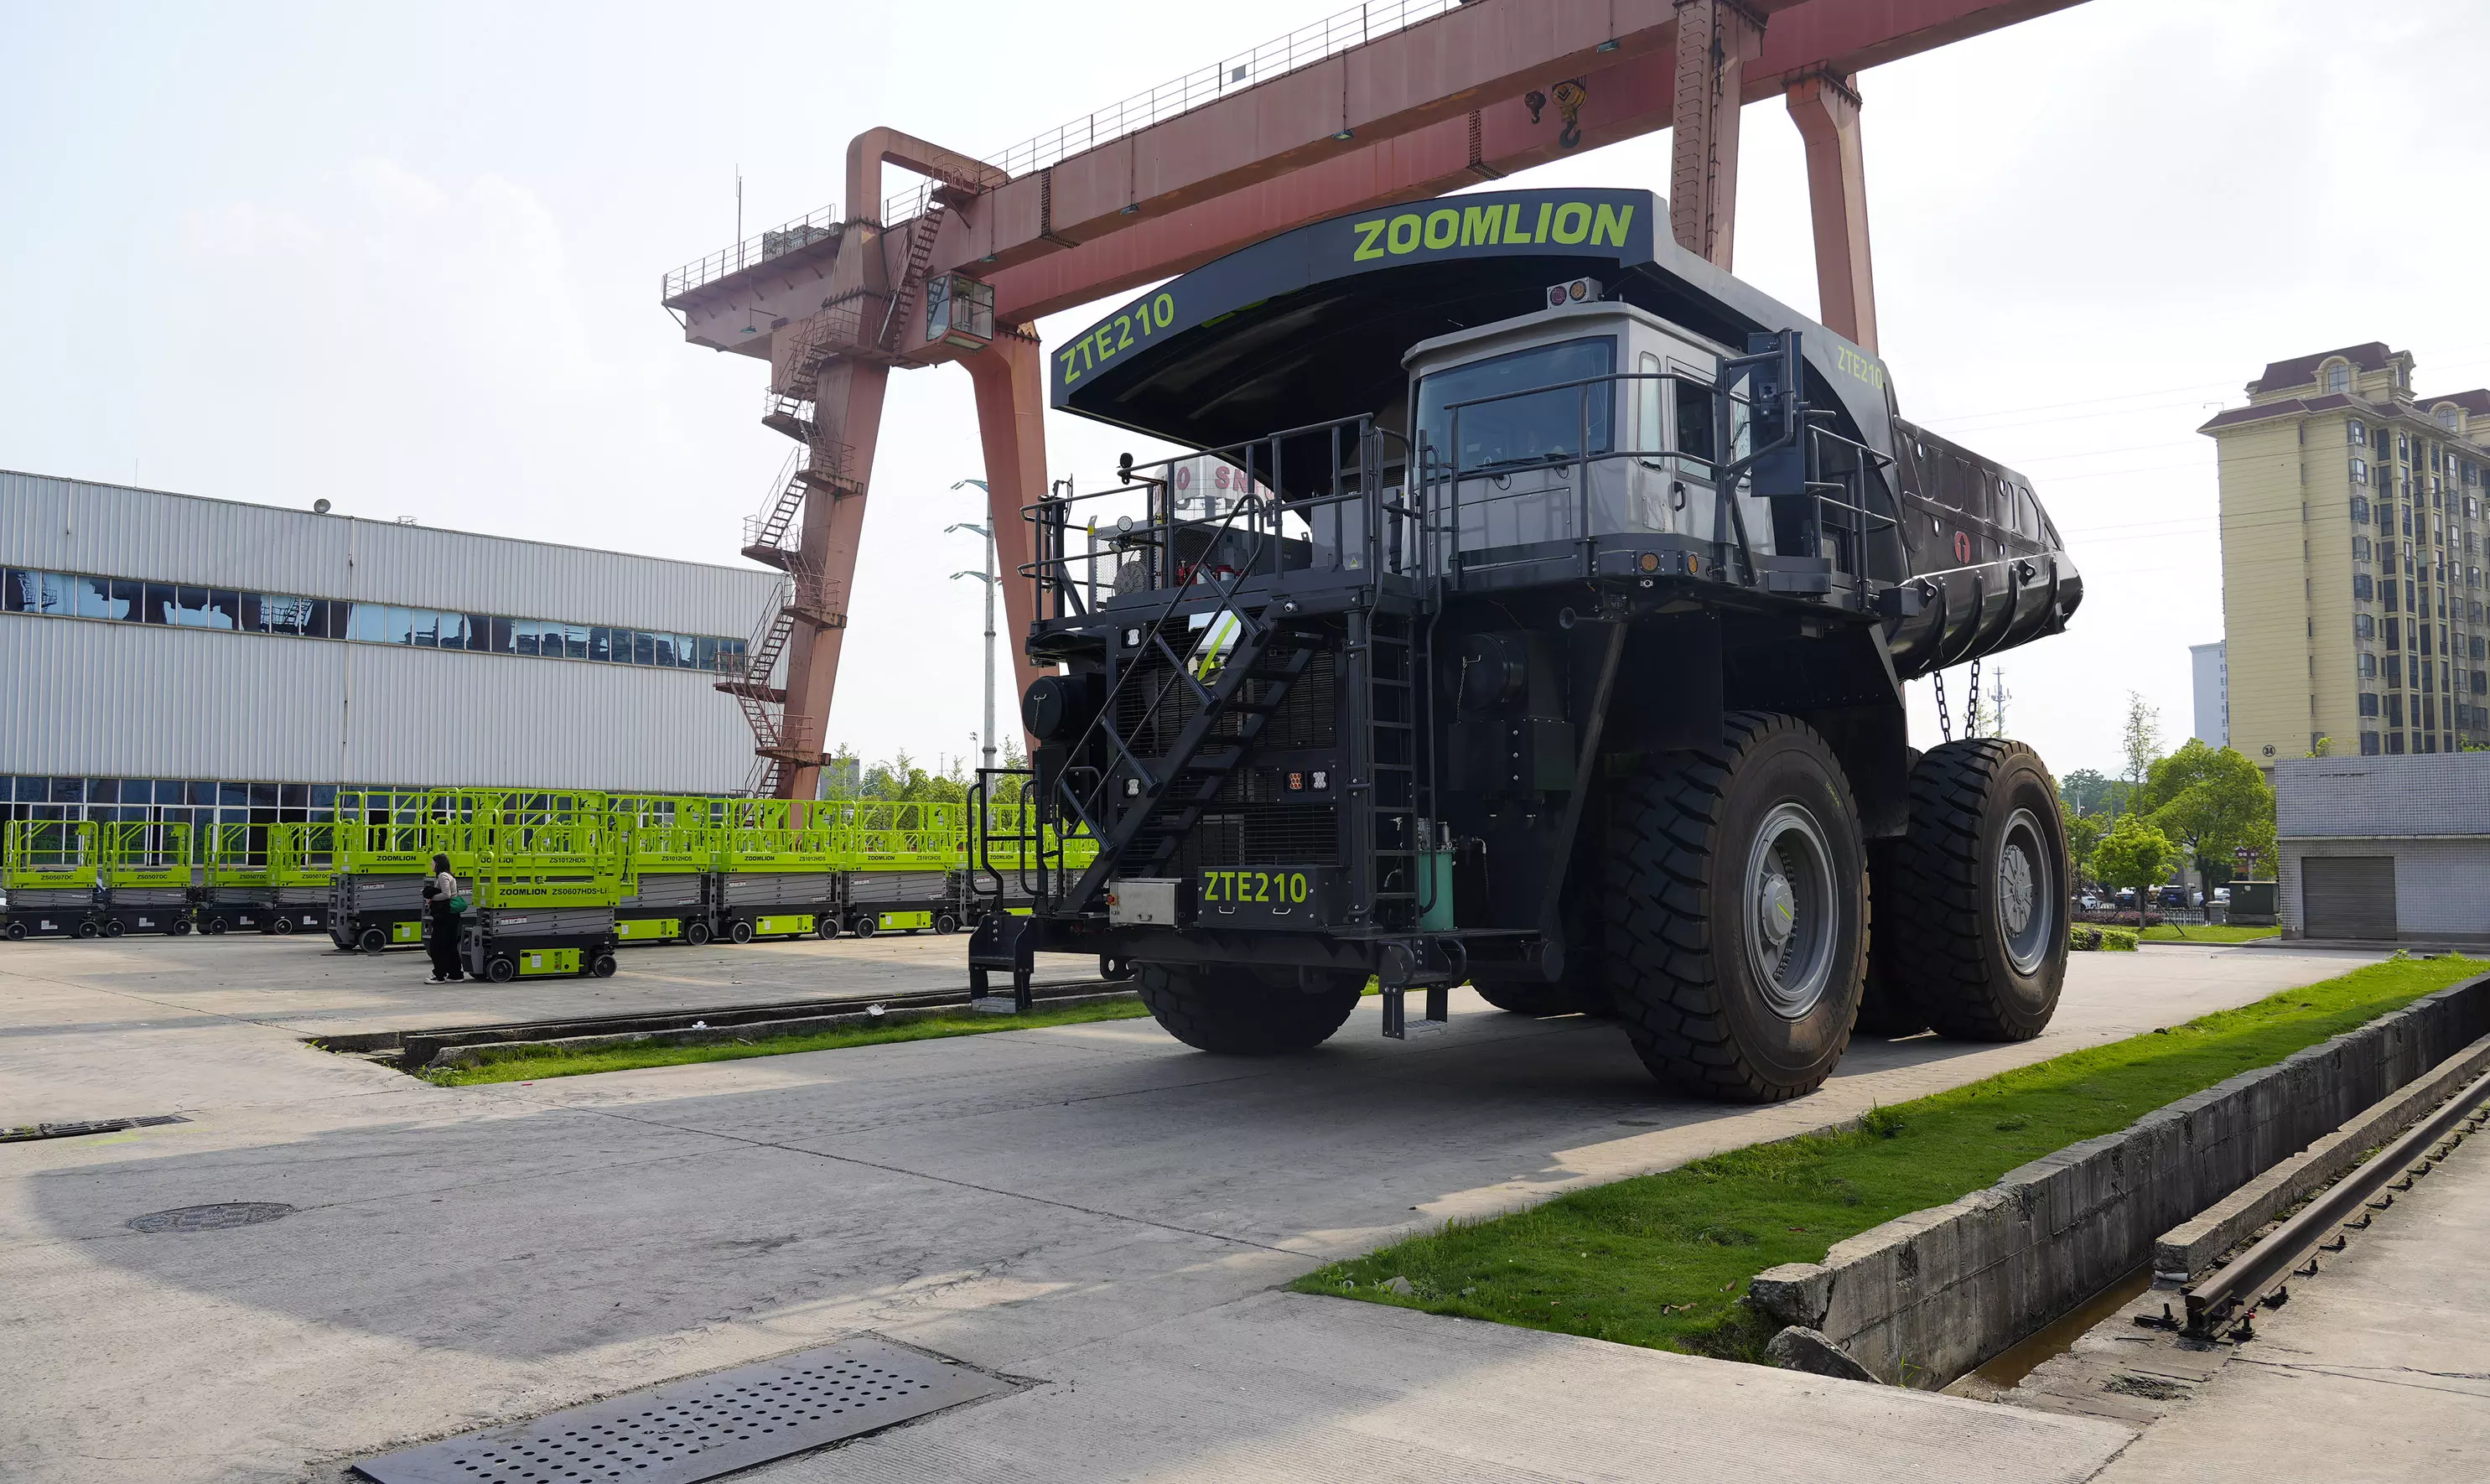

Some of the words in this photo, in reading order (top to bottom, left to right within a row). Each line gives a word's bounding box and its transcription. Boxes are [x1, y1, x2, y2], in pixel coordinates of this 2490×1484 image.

[1353, 201, 1635, 262] ZOOMLION
[1059, 293, 1175, 385] ZTE210
[1838, 345, 1883, 390] ZTE210
[1204, 871, 1307, 903] ZTE210
